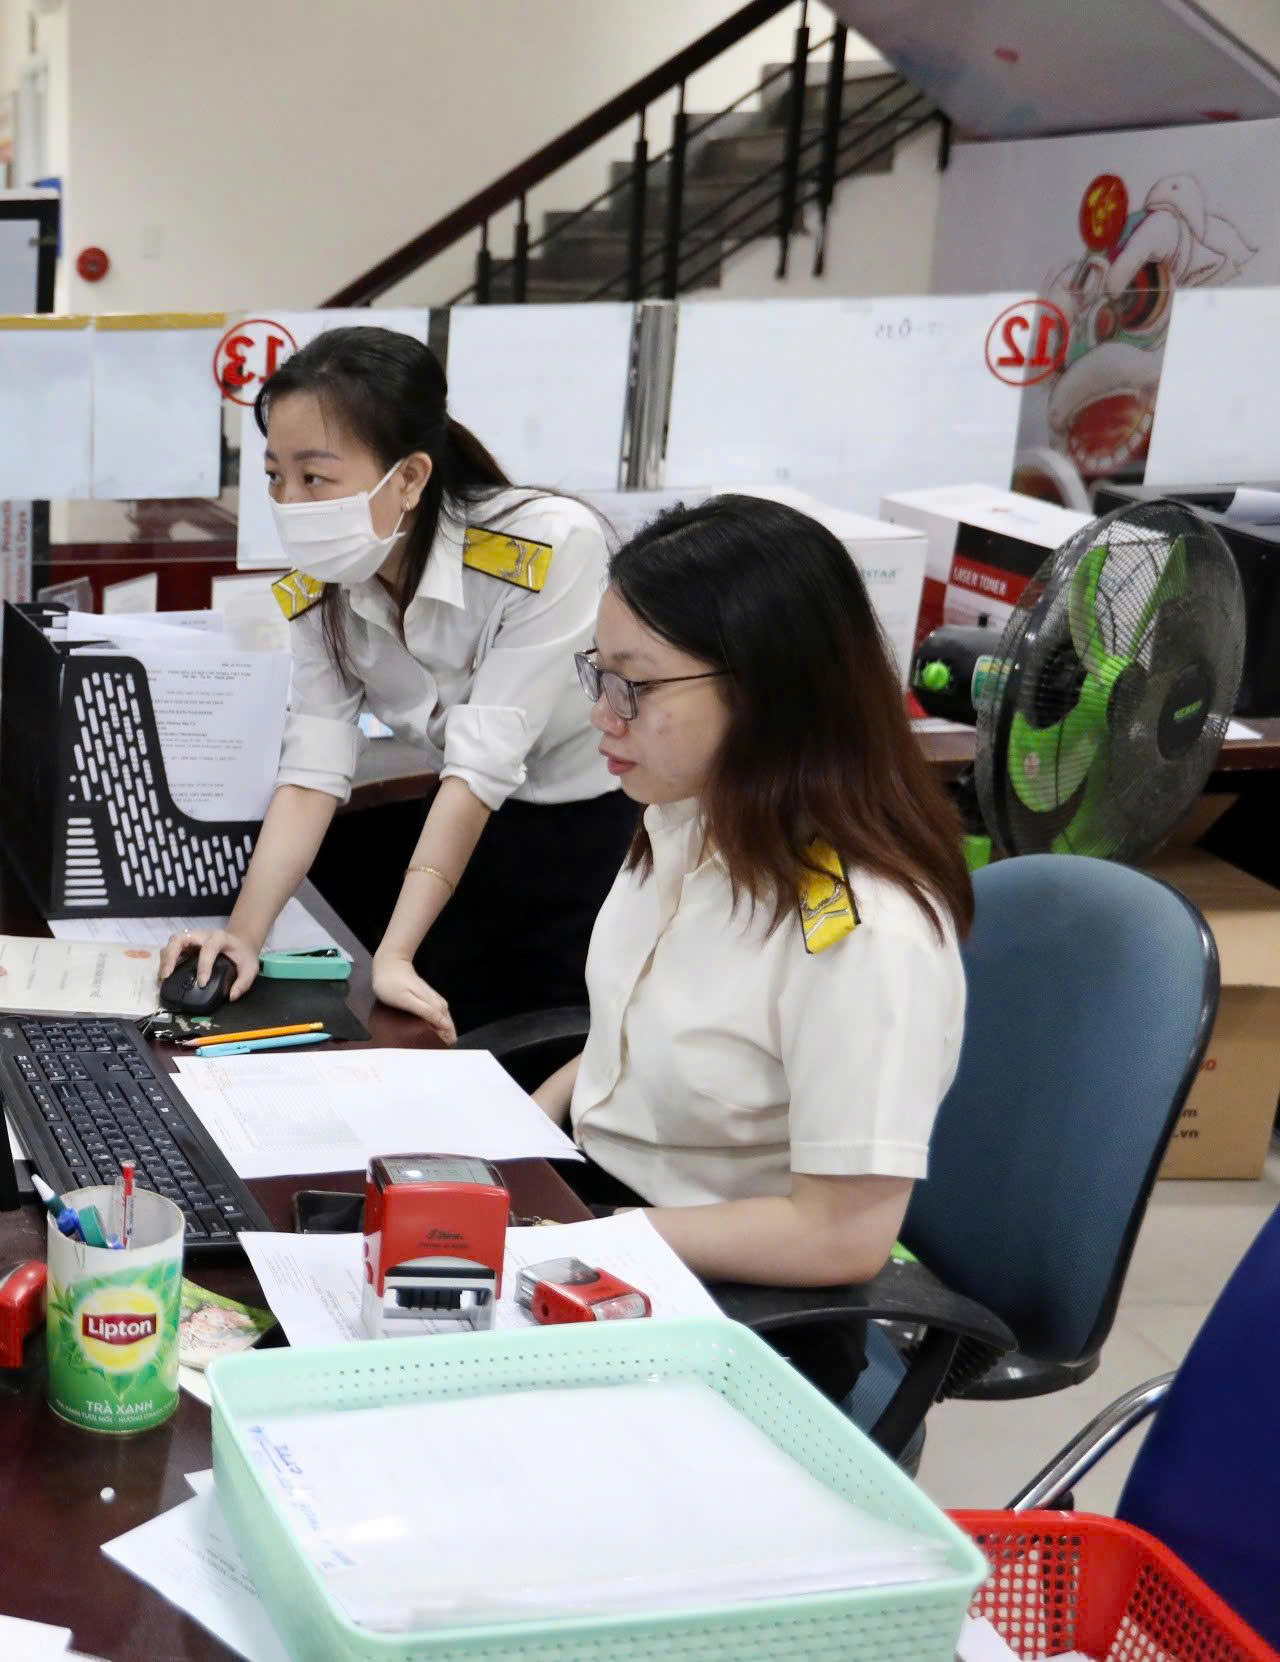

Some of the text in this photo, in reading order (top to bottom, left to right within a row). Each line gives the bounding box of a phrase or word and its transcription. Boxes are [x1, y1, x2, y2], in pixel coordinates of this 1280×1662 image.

[952, 566, 1008, 597] LASER TONER
[88, 1317, 152, 1340] Lipton
[86, 1399, 112, 1414] TRÀ
[115, 1399, 152, 1414] XANH
